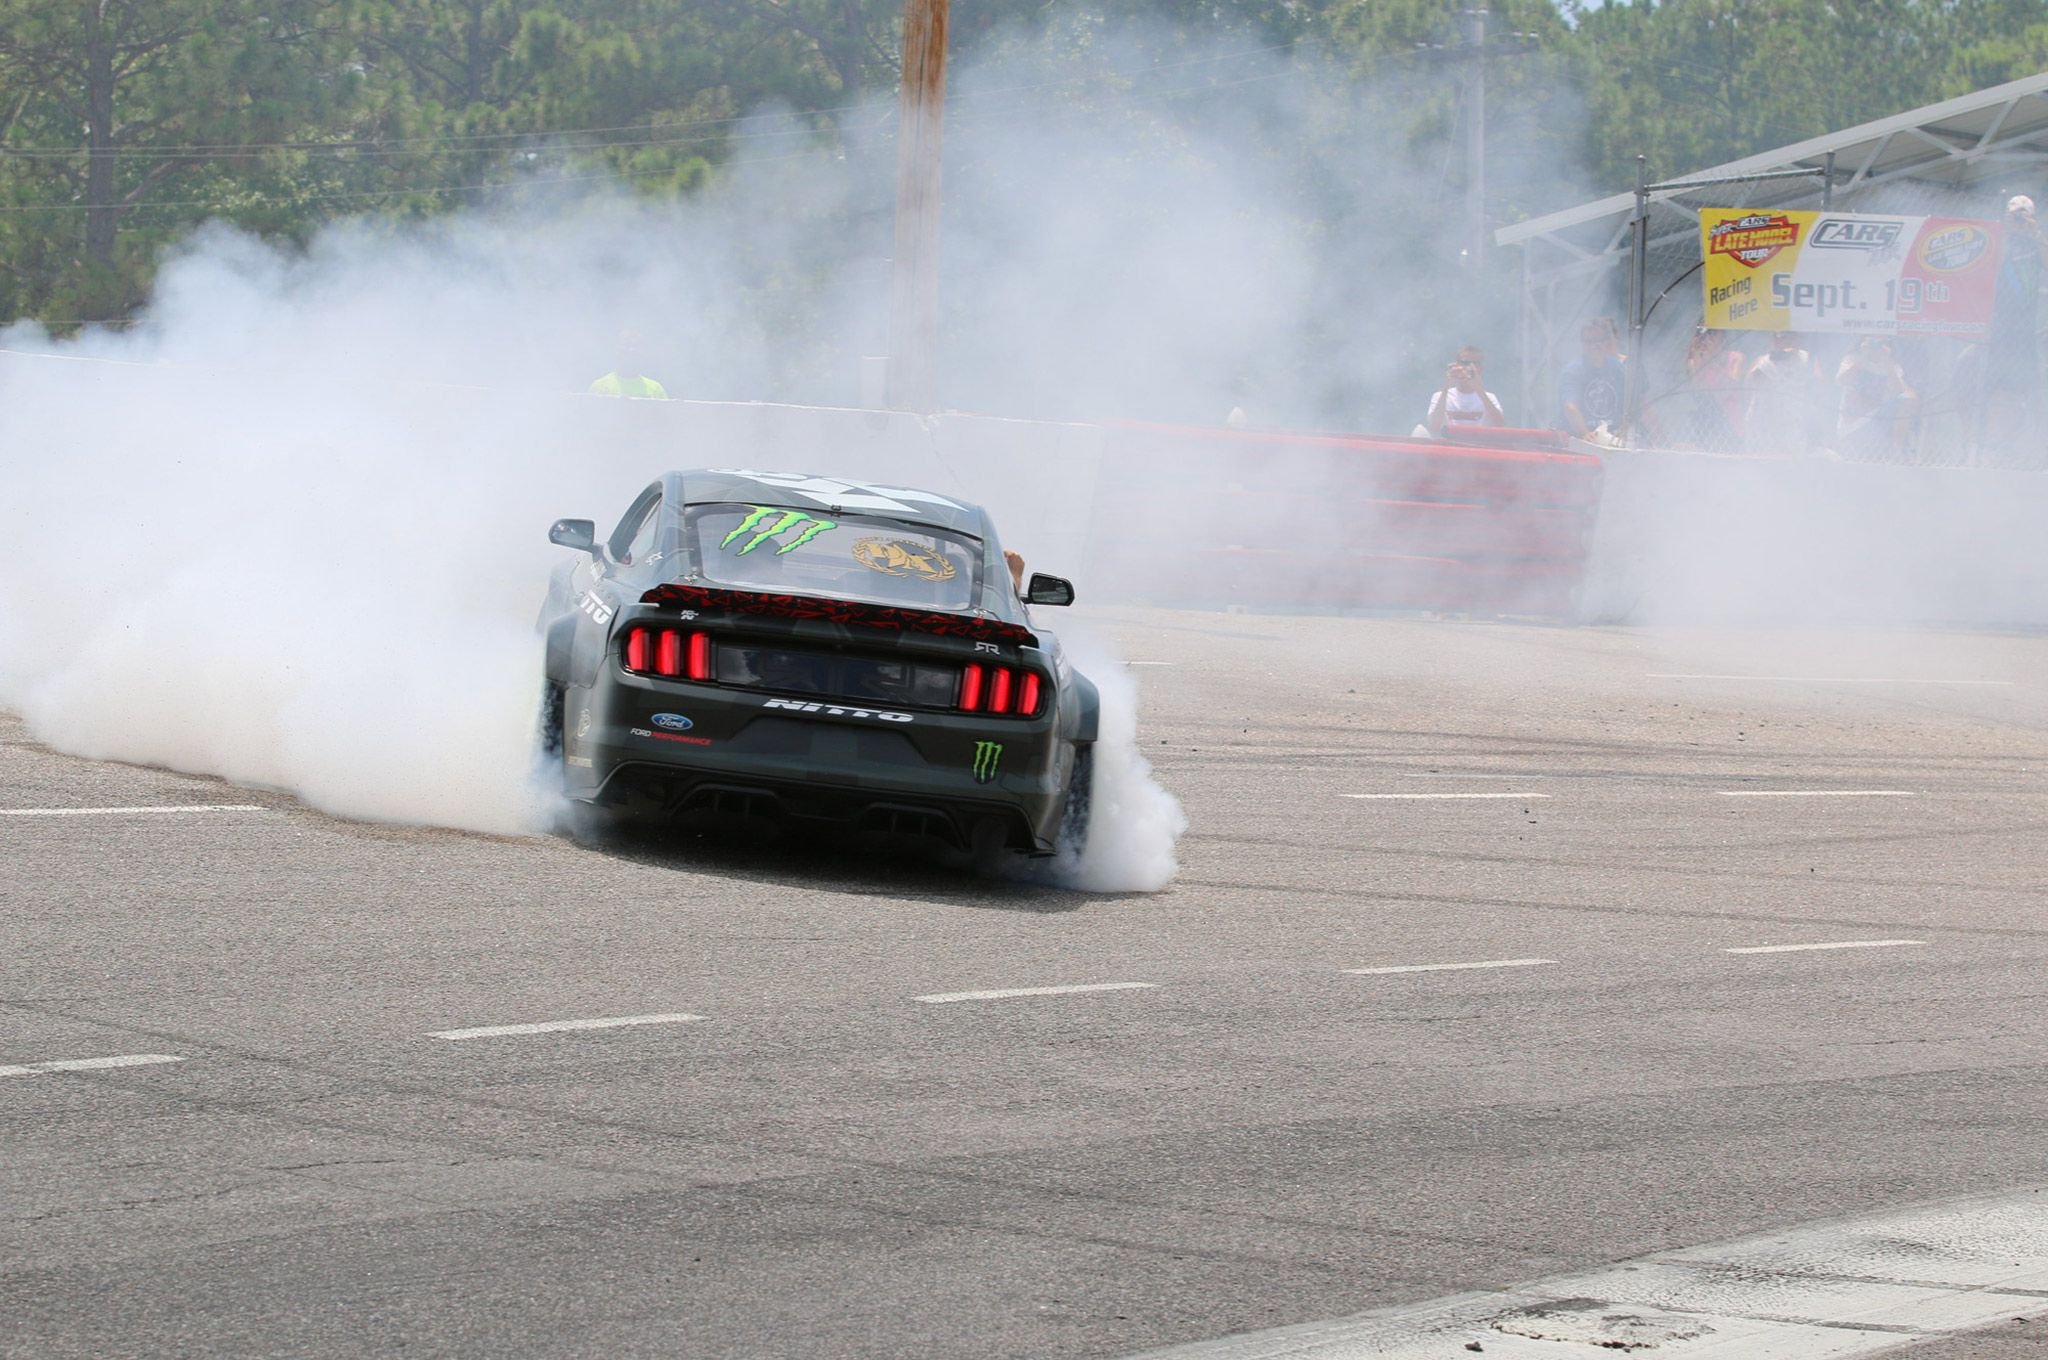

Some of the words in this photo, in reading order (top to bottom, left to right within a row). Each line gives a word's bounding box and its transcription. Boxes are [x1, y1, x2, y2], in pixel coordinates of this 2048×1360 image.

[1715, 232, 1749, 251] LATE
[1749, 227, 1793, 248] MODEL
[1811, 220, 1903, 249] CARS
[1740, 248, 1769, 261] TOUR
[1710, 276, 1751, 306] Racing
[1771, 273, 1867, 316] Sept.
[1729, 299, 1758, 321] Here
[763, 698, 914, 722] NITTO
[630, 727, 652, 738] FORD
